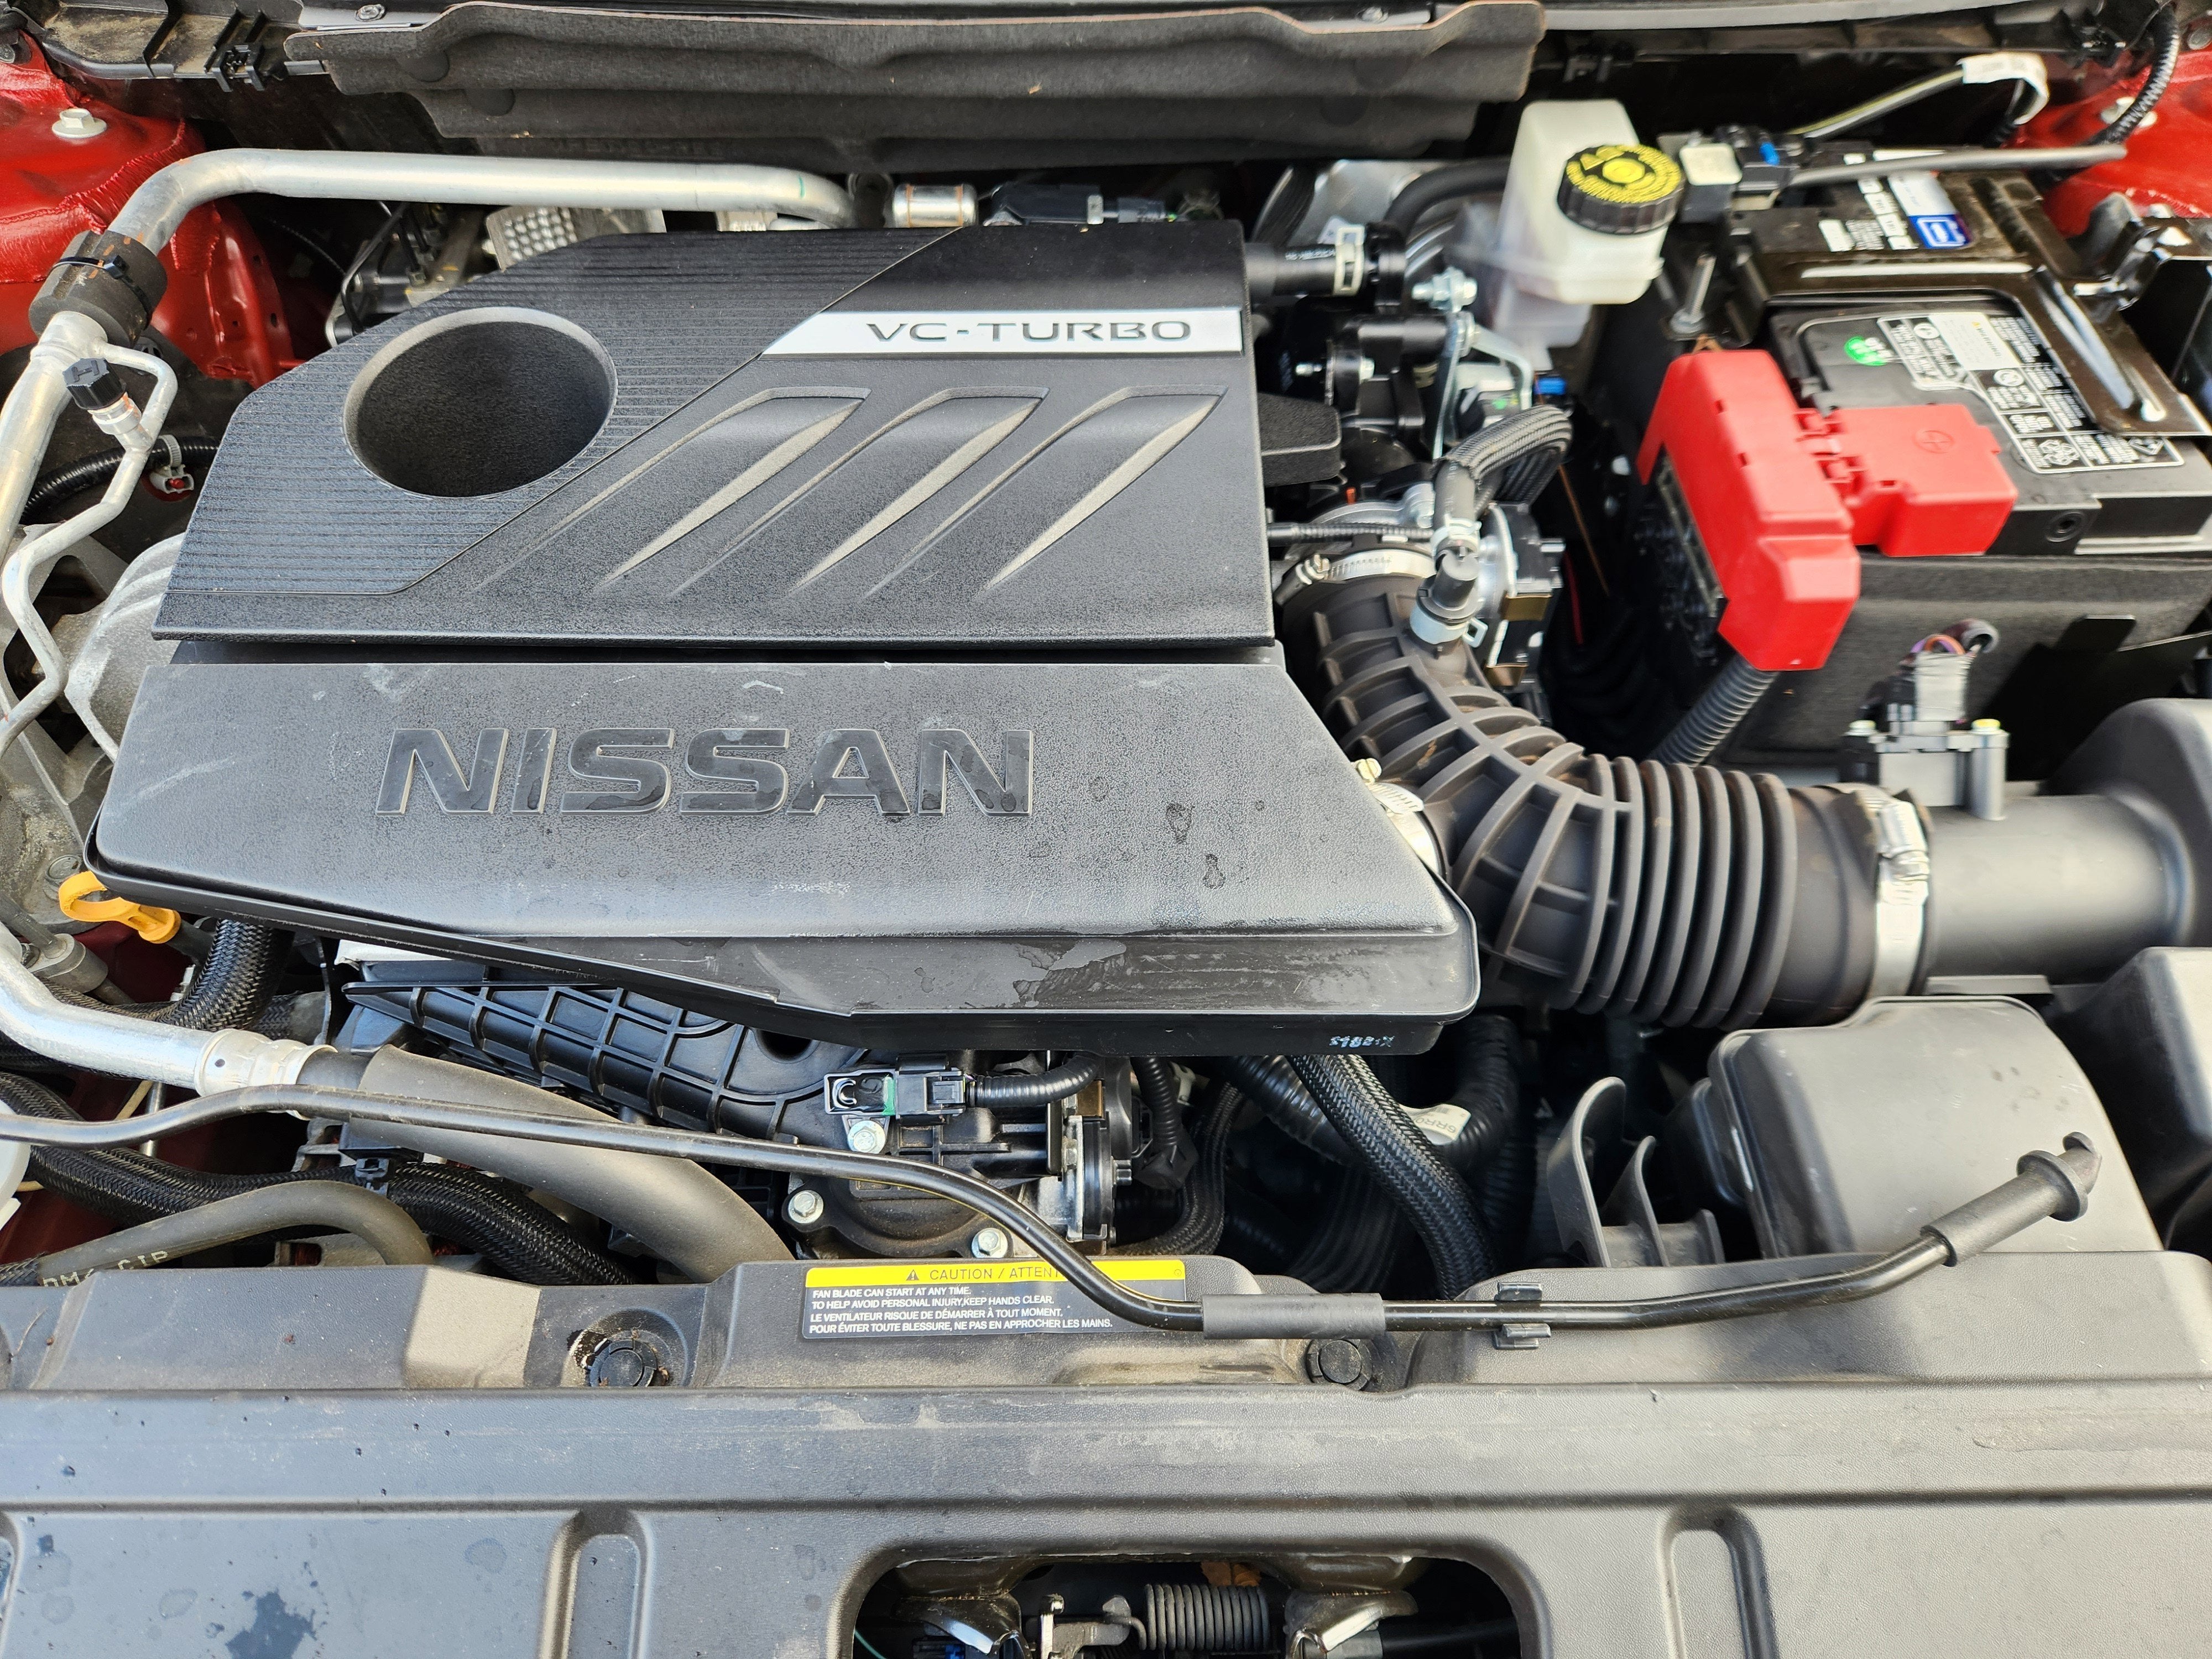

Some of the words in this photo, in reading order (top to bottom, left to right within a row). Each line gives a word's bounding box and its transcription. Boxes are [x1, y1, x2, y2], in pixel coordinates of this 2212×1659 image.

[866, 321, 1191, 342] VC-TURBO
[71, 359, 100, 383] H
[375, 728, 1033, 817] NISSAN
[930, 1268, 993, 1280] CAUTION
[813, 1290, 831, 1298] FAN
[832, 1289, 863, 1298] BLADE
[864, 1288, 884, 1297] CAN
[885, 1288, 914, 1296] START
[915, 1287, 927, 1296] AT
[948, 1286, 972, 1295] TIME.
[811, 1301, 825, 1310] TO
[826, 1300, 851, 1310] HELP
[851, 1300, 880, 1308] AVOID
[881, 1298, 931, 1308] PERSONAL
[988, 1296, 1021, 1306] HANDS
[1022, 1295, 1055, 1304] CLEAR.
[810, 1313, 823, 1322] LE
[823, 1312, 883, 1322] VENTILATEUR
[884, 1311, 920, 1321] RISQUE
[920, 1311, 934, 1319] DE
[935, 1308, 985, 1319] DÉMARRER
[987, 1307, 994, 1318] À
[995, 1308, 1020, 1318] TOUT
[1021, 1307, 1063, 1317] MOMENT.
[809, 1324, 837, 1333] POUR
[837, 1321, 870, 1333] ÉVITER
[870, 1323, 901, 1332] TOUTE
[901, 1321, 953, 1332] BLESSURE,
[954, 1321, 968, 1330] NE
[968, 1321, 988, 1329] PAS
[988, 1320, 1002, 1329] EN
[1003, 1318, 1061, 1329] APPROCHER
[1062, 1319, 1080, 1328] LES
[1081, 1318, 1113, 1328] MAINS.
